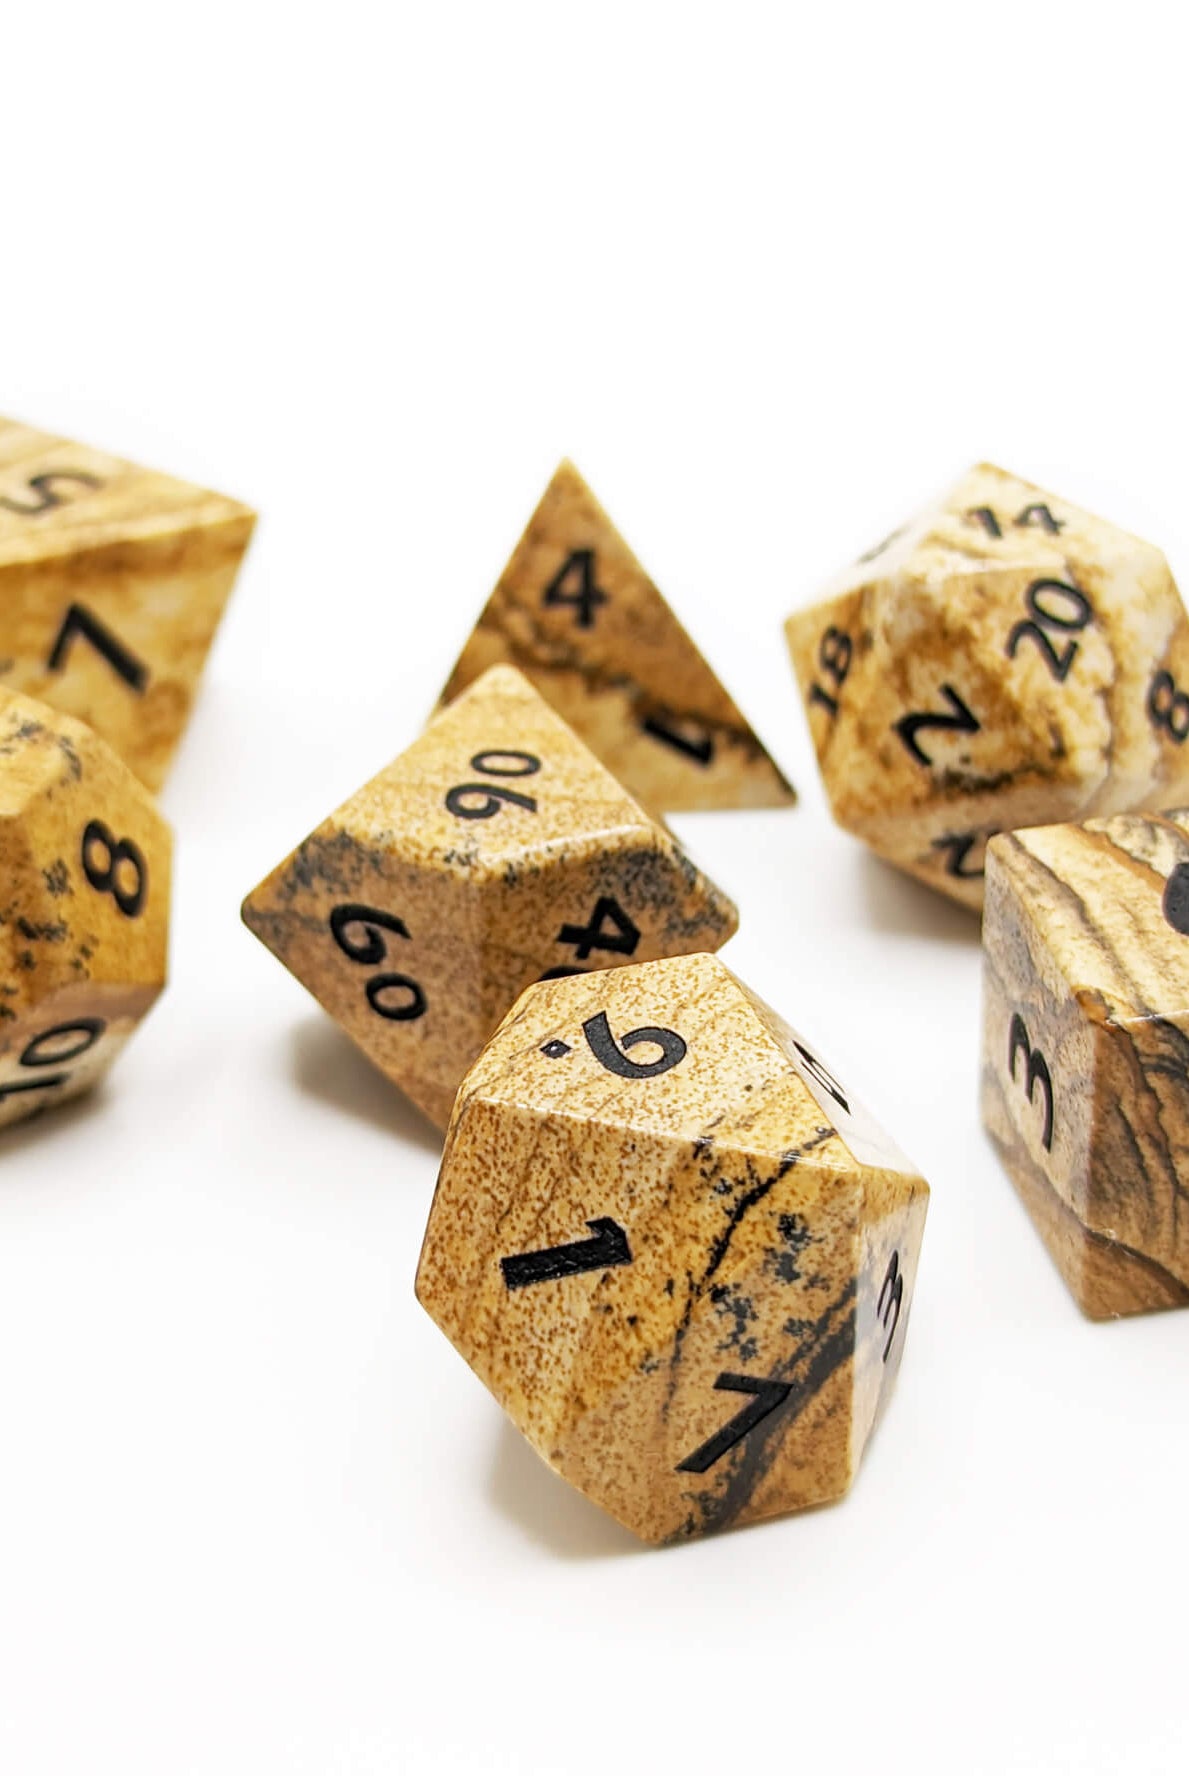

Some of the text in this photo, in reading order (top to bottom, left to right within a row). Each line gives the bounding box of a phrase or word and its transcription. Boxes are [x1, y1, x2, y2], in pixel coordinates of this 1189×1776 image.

[965, 503, 1066, 539] 14
[543, 548, 608, 630] 4
[1005, 577, 1094, 683] 20
[47, 602, 149, 693] 7
[808, 625, 857, 721] 18
[643, 715, 714, 768] 1
[892, 683, 982, 767] 2
[444, 748, 542, 821] 90
[80, 818, 147, 919] 8
[328, 902, 429, 1023] 60
[538, 894, 642, 982] 4
[1008, 1012, 1054, 1155] 3
[500, 1216, 634, 1291] 1
[876, 1249, 905, 1365] 3
[674, 1372, 795, 1474] 7
